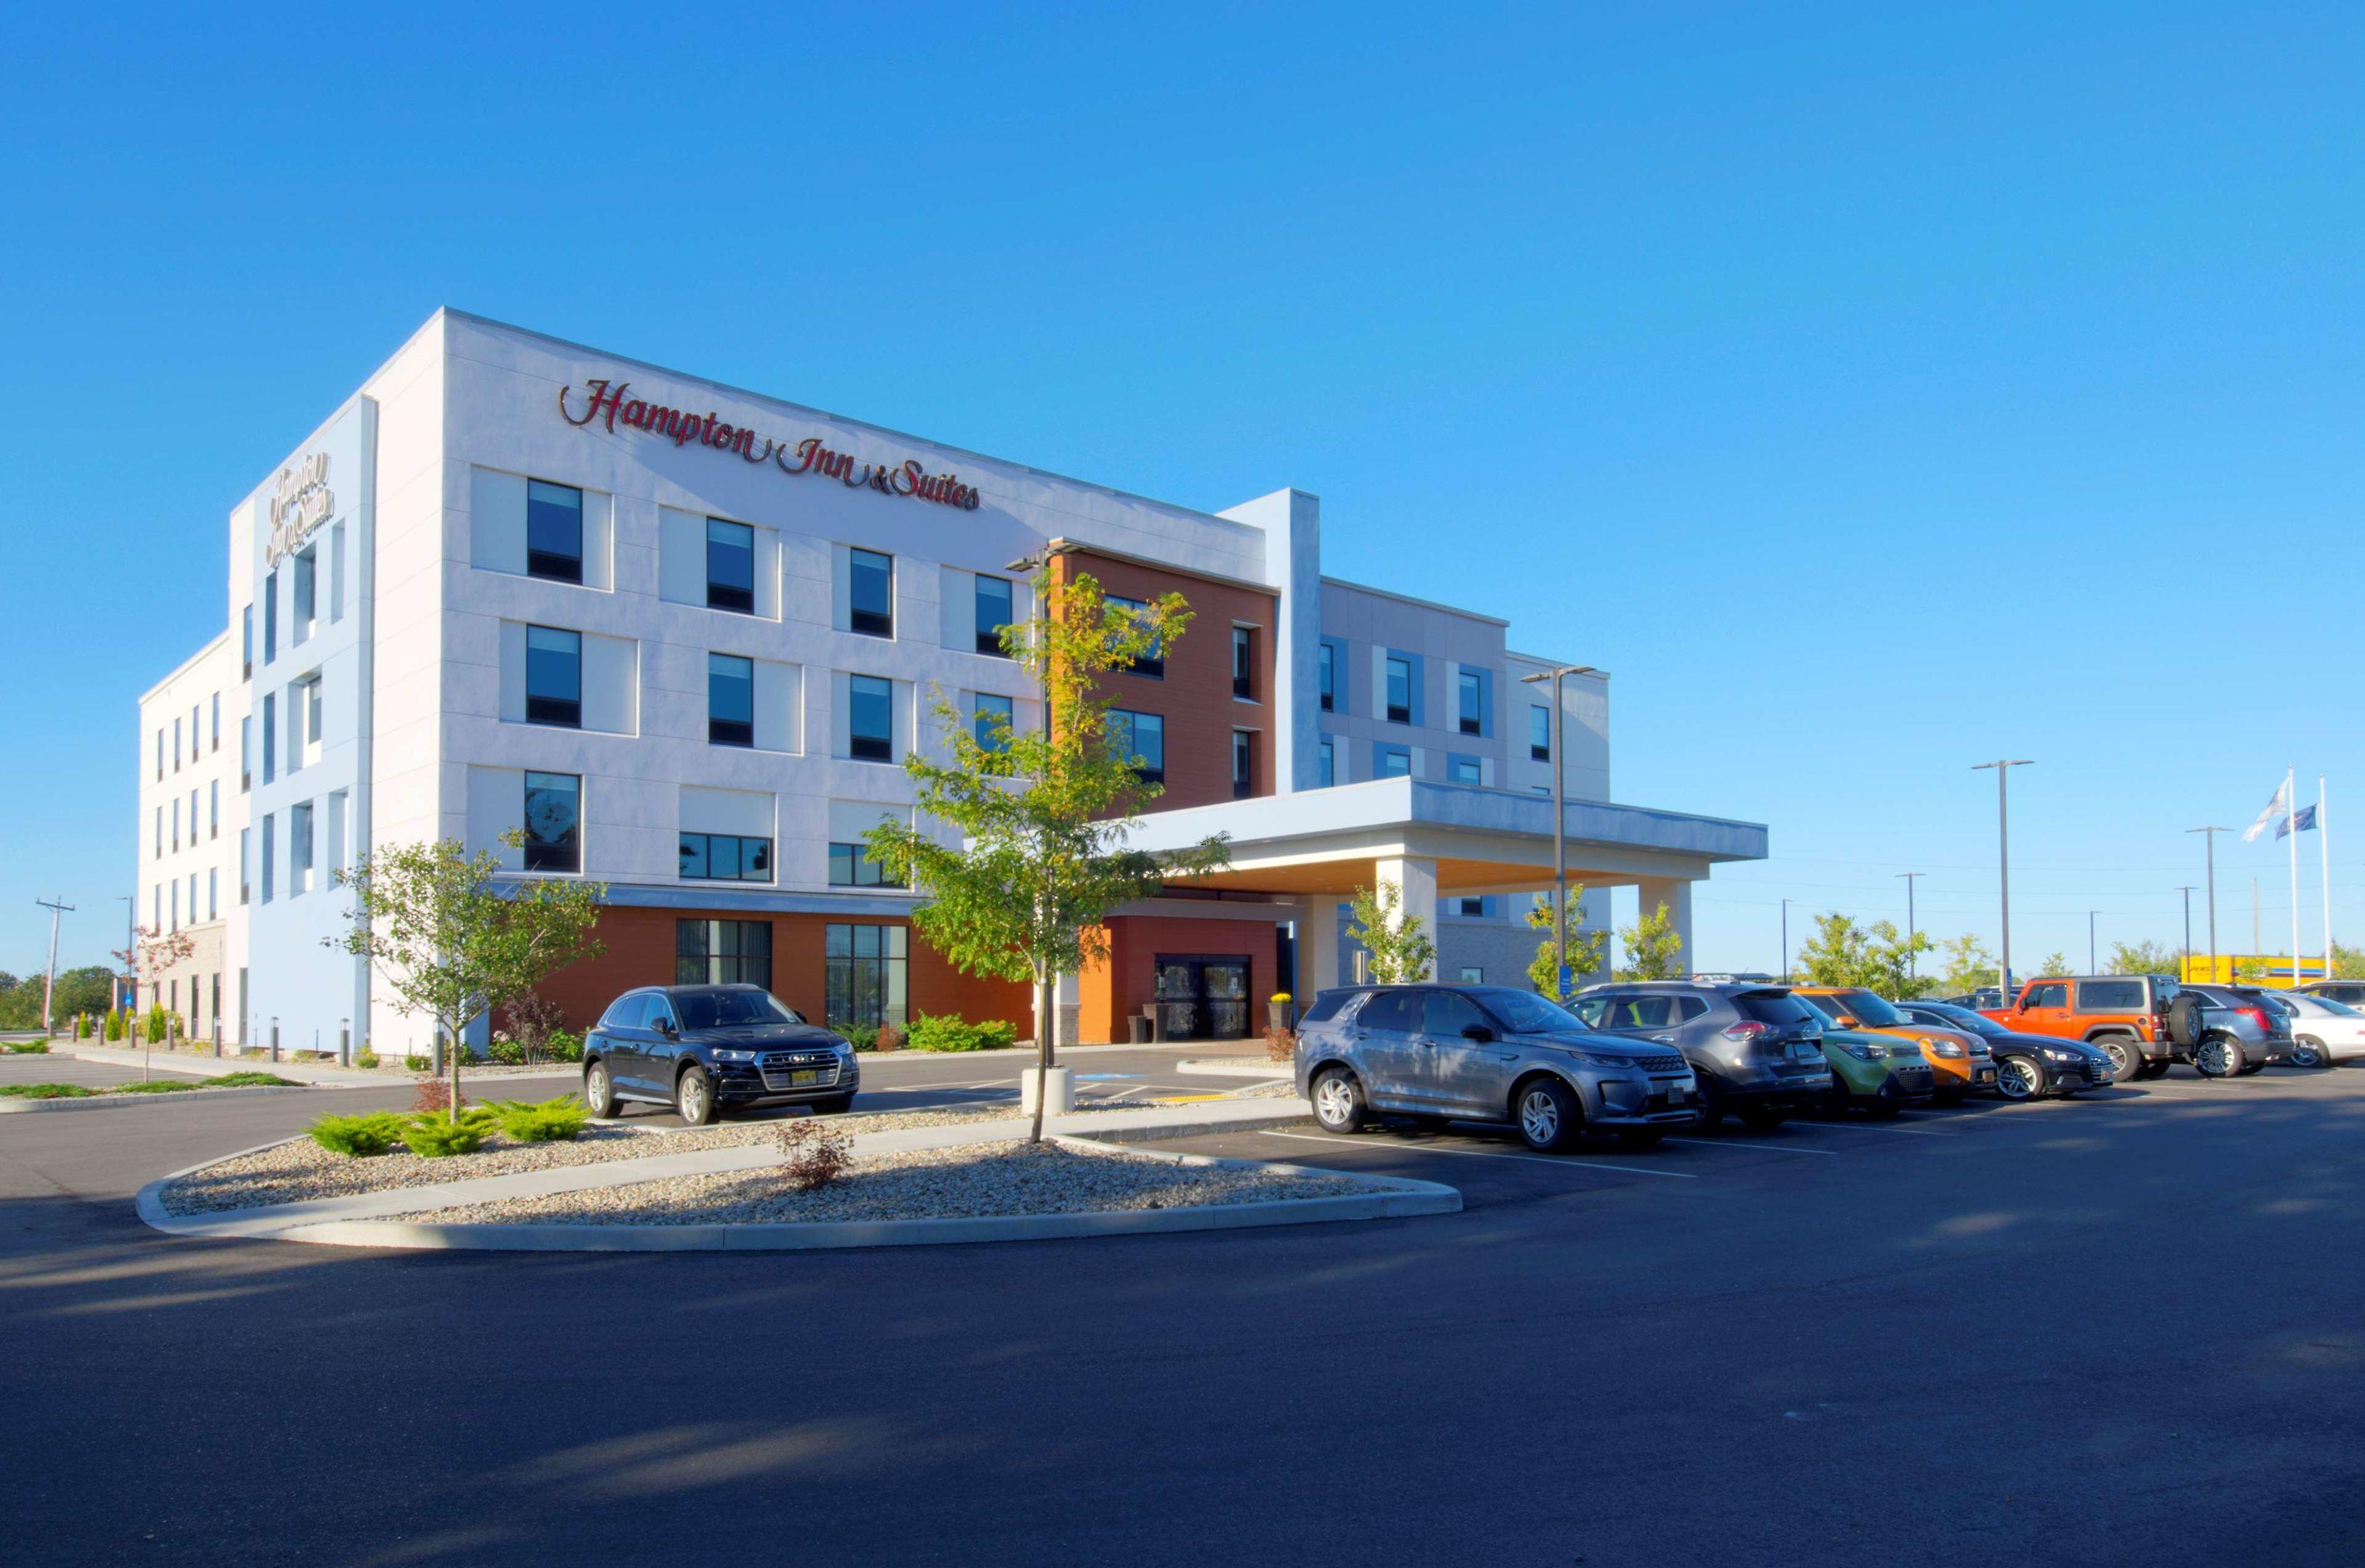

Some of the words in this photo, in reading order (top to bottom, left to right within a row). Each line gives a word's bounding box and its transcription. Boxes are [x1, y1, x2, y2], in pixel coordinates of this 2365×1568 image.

[558, 380, 772, 462] Hampton
[776, 439, 870, 487] Inn
[870, 465, 894, 495] &
[890, 460, 979, 510] Suites
